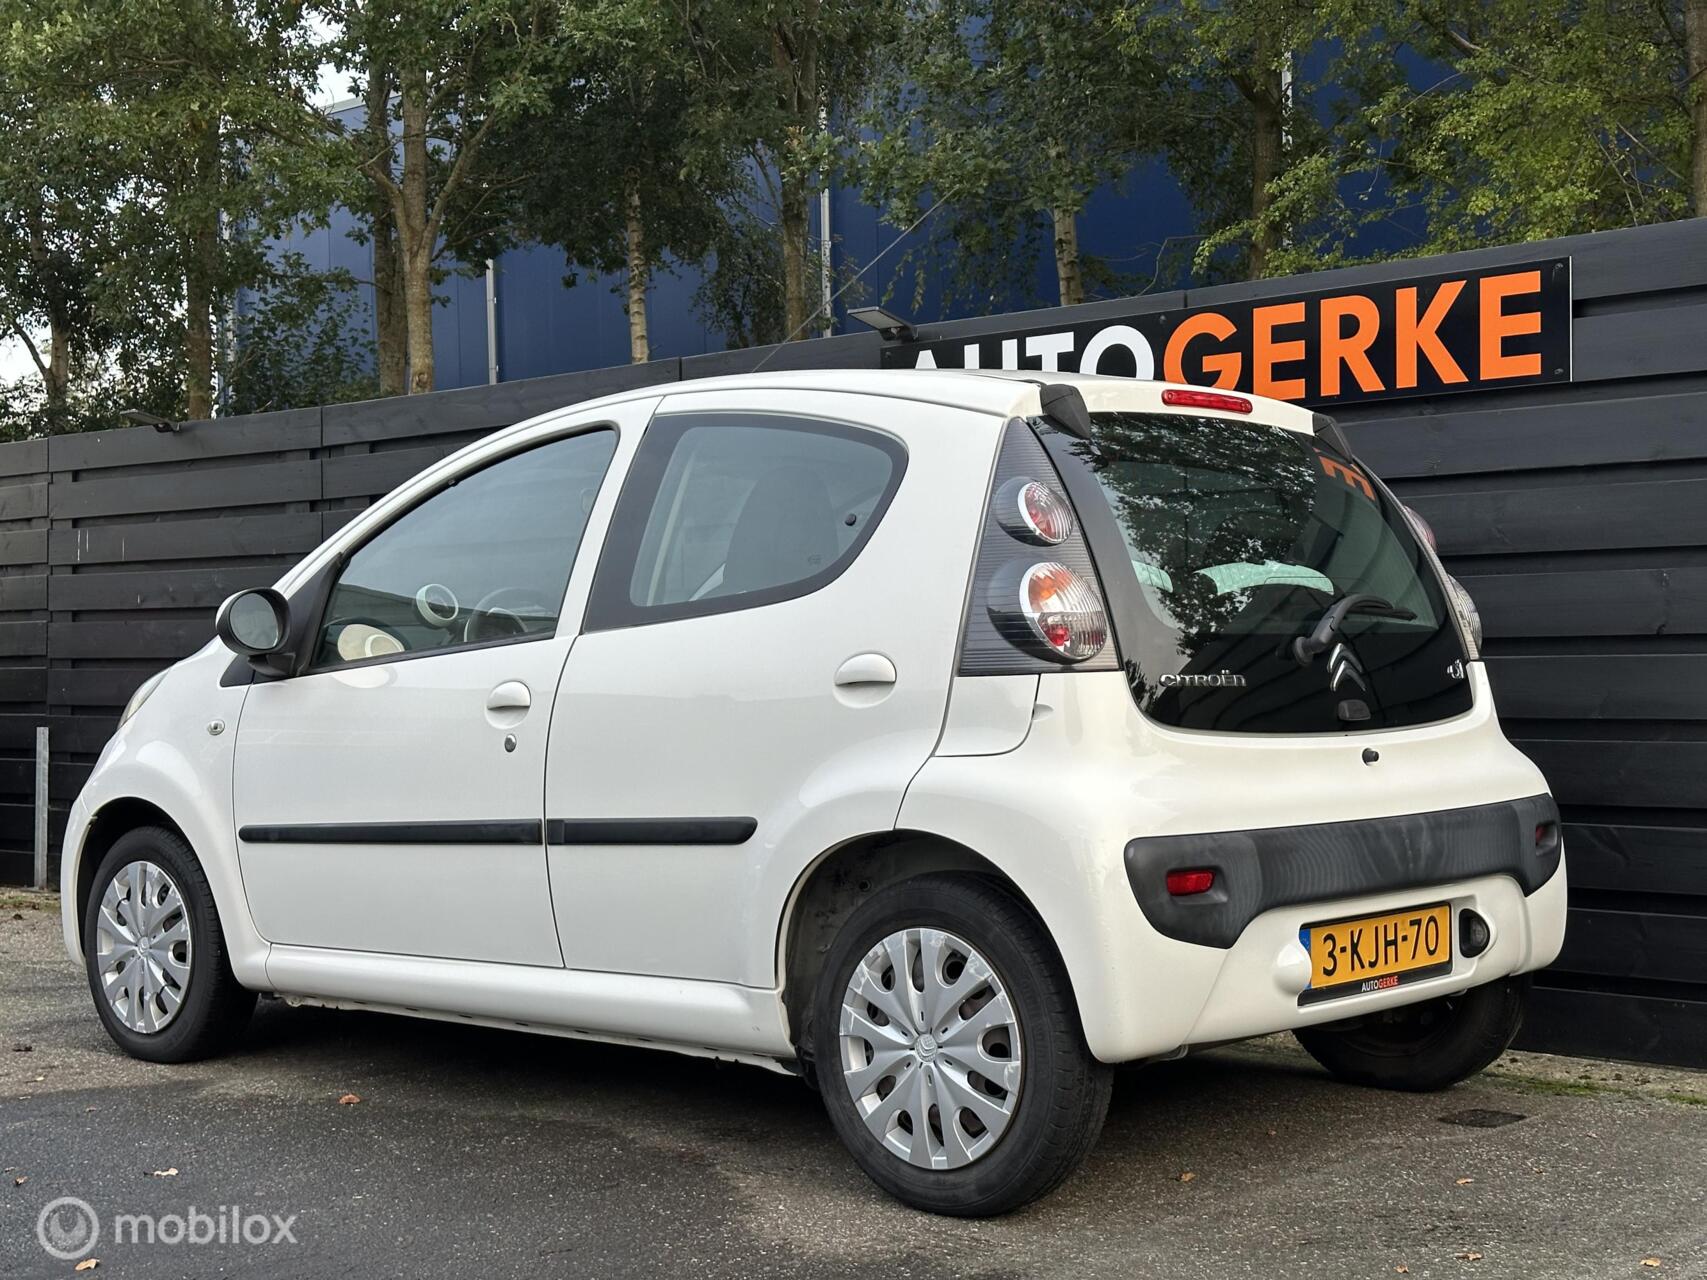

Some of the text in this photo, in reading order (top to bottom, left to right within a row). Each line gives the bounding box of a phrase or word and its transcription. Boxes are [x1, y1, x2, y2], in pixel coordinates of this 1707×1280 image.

[915, 270, 1542, 400] TOGERKE
[1322, 915, 1439, 977] 3-KJH-70
[1361, 975, 1399, 992] AUTOGERKE
